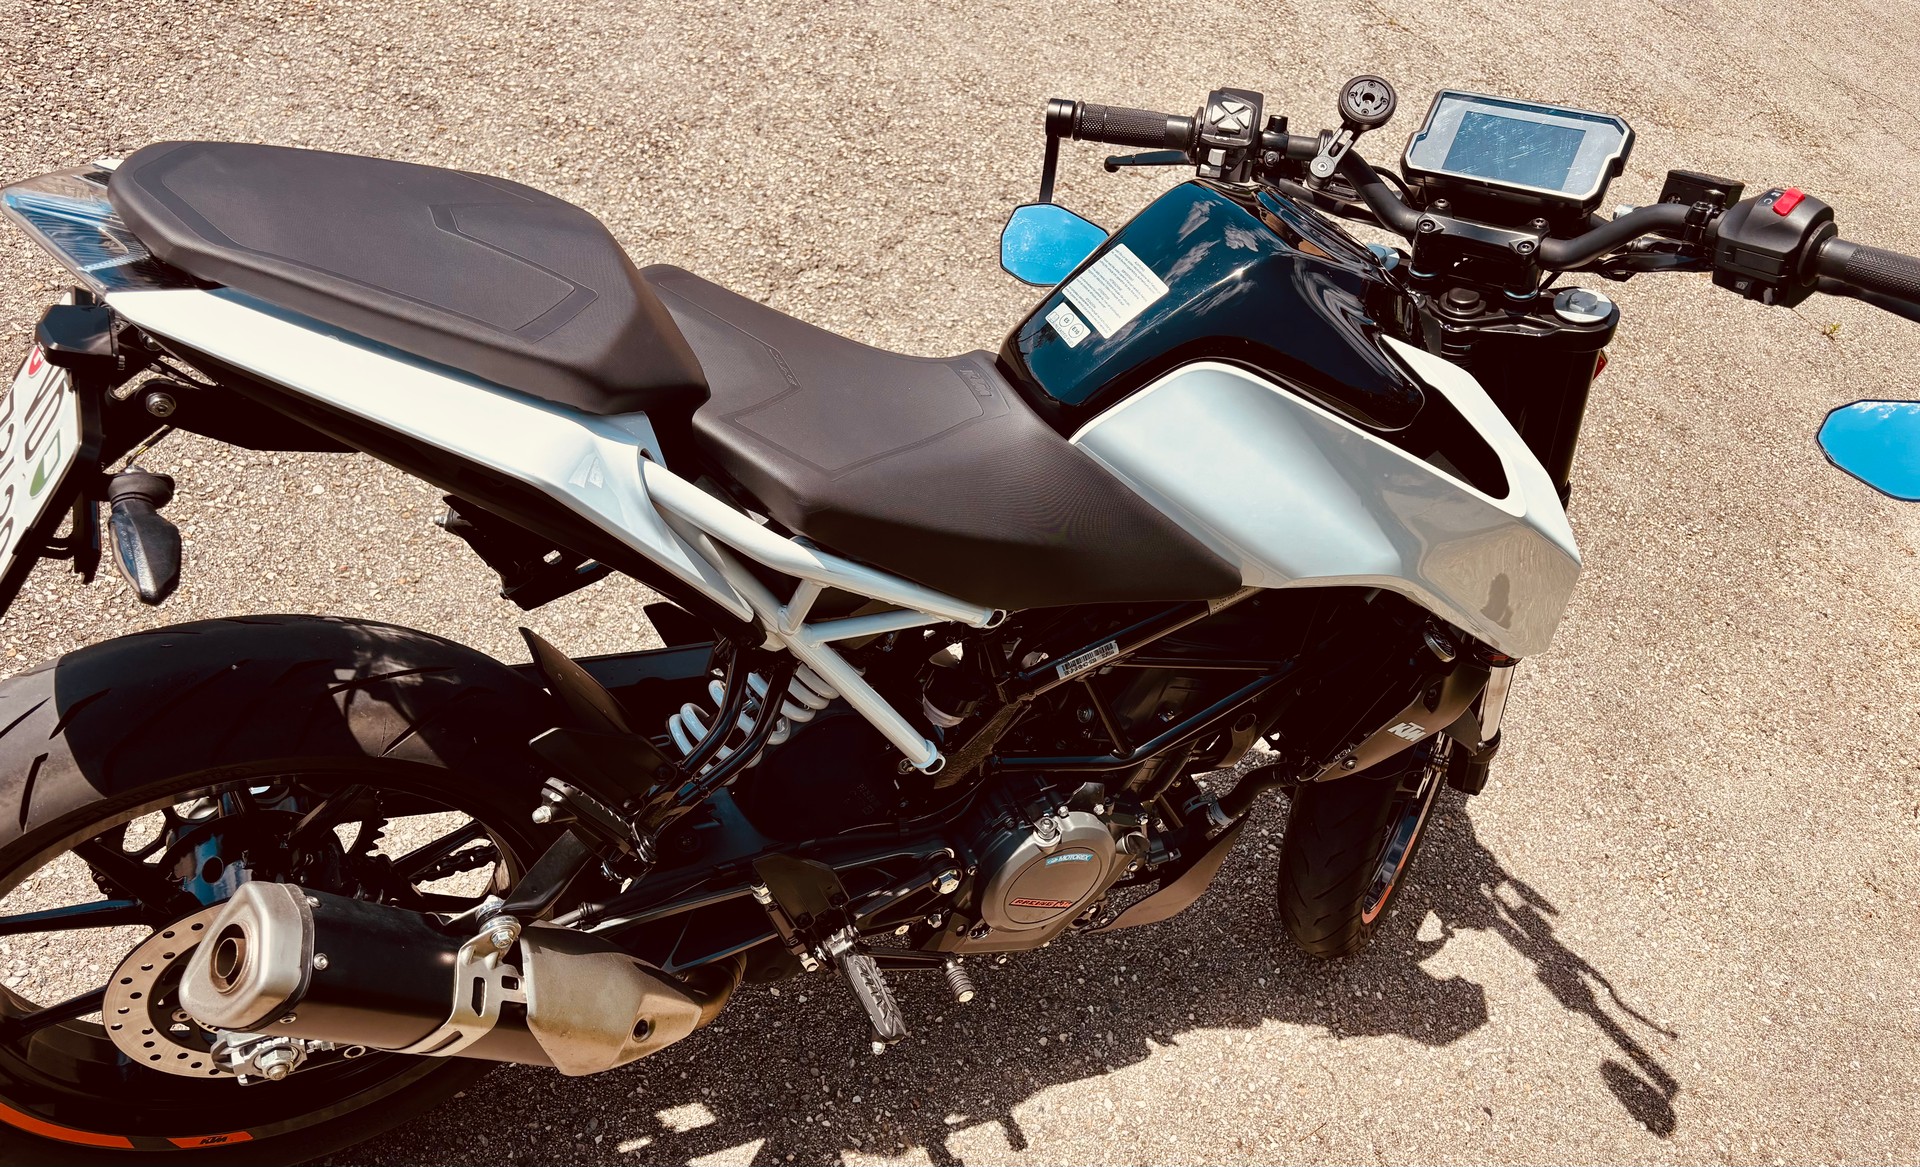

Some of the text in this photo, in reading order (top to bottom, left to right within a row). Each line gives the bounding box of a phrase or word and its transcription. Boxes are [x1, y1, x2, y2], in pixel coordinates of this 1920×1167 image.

[1387, 722, 1427, 742] KTM
[1058, 853, 1091, 862] MOTOREX
[199, 1135, 228, 1145] KTM
